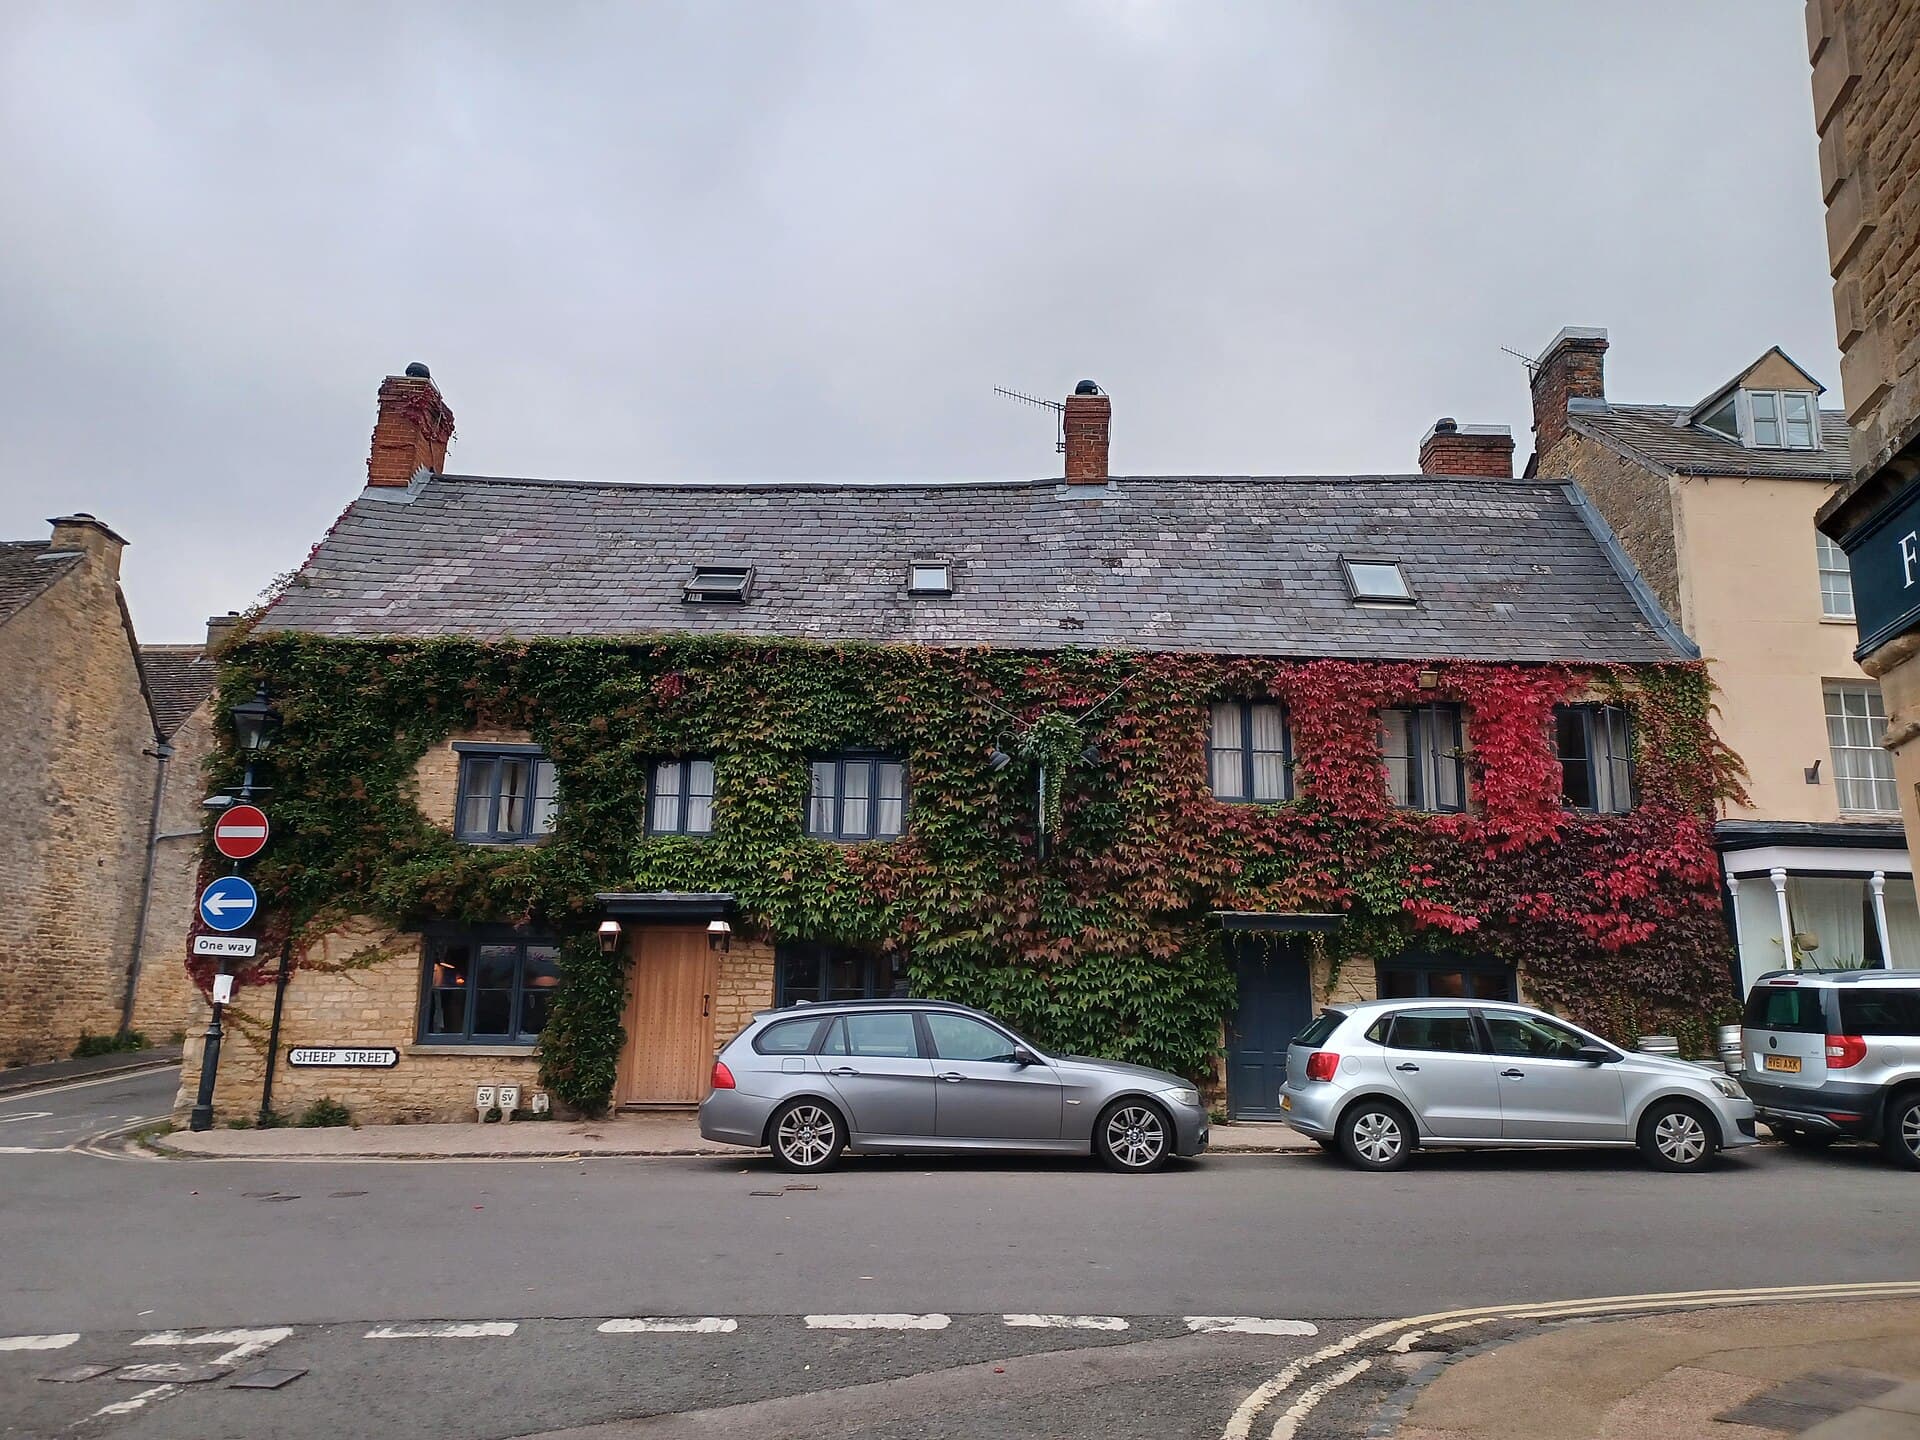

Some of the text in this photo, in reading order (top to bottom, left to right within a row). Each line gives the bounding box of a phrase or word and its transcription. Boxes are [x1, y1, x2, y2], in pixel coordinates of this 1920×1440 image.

[199, 940, 252, 953] One way
[295, 1051, 390, 1063] SHEEP STREET
[1783, 1058, 1798, 1070] AXK
[479, 1093, 491, 1101] SV
[501, 1093, 514, 1102] SV
